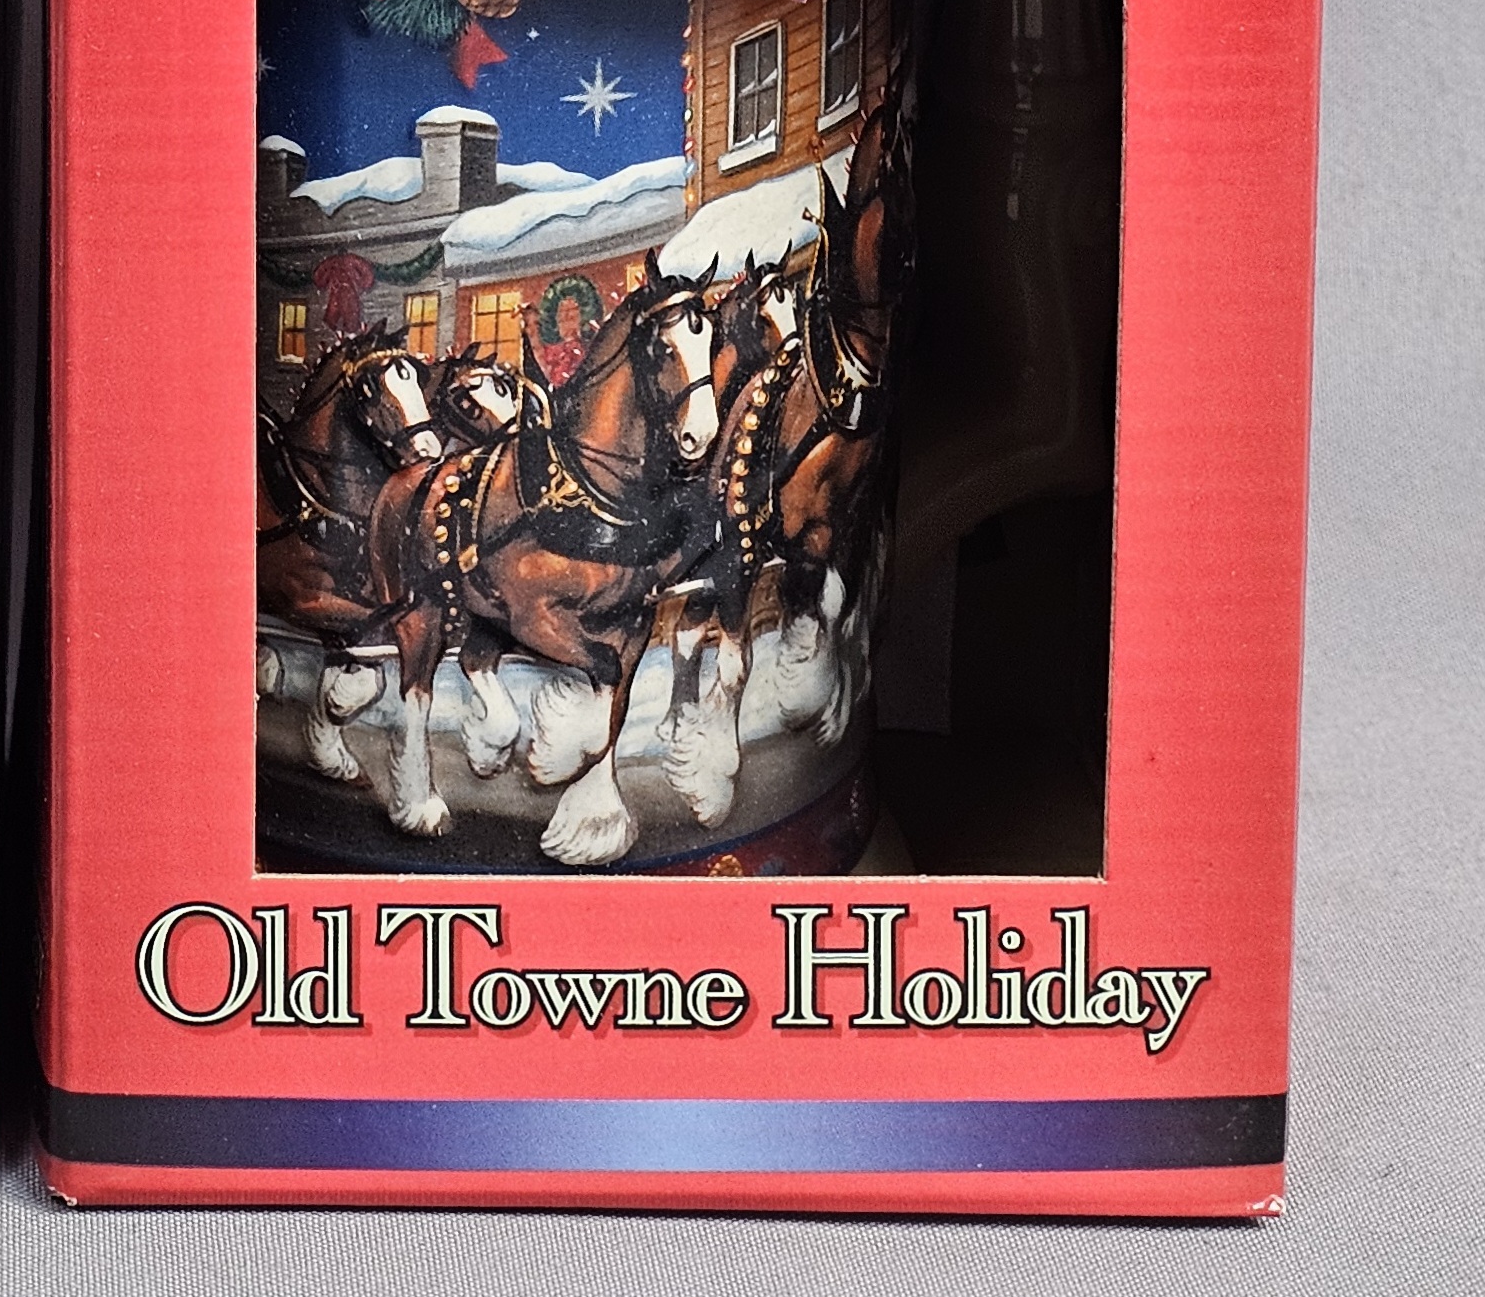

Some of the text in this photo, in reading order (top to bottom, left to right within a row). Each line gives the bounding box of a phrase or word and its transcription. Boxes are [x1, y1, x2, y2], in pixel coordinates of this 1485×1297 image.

[134, 899, 1212, 1057] Old Towne Holiday
